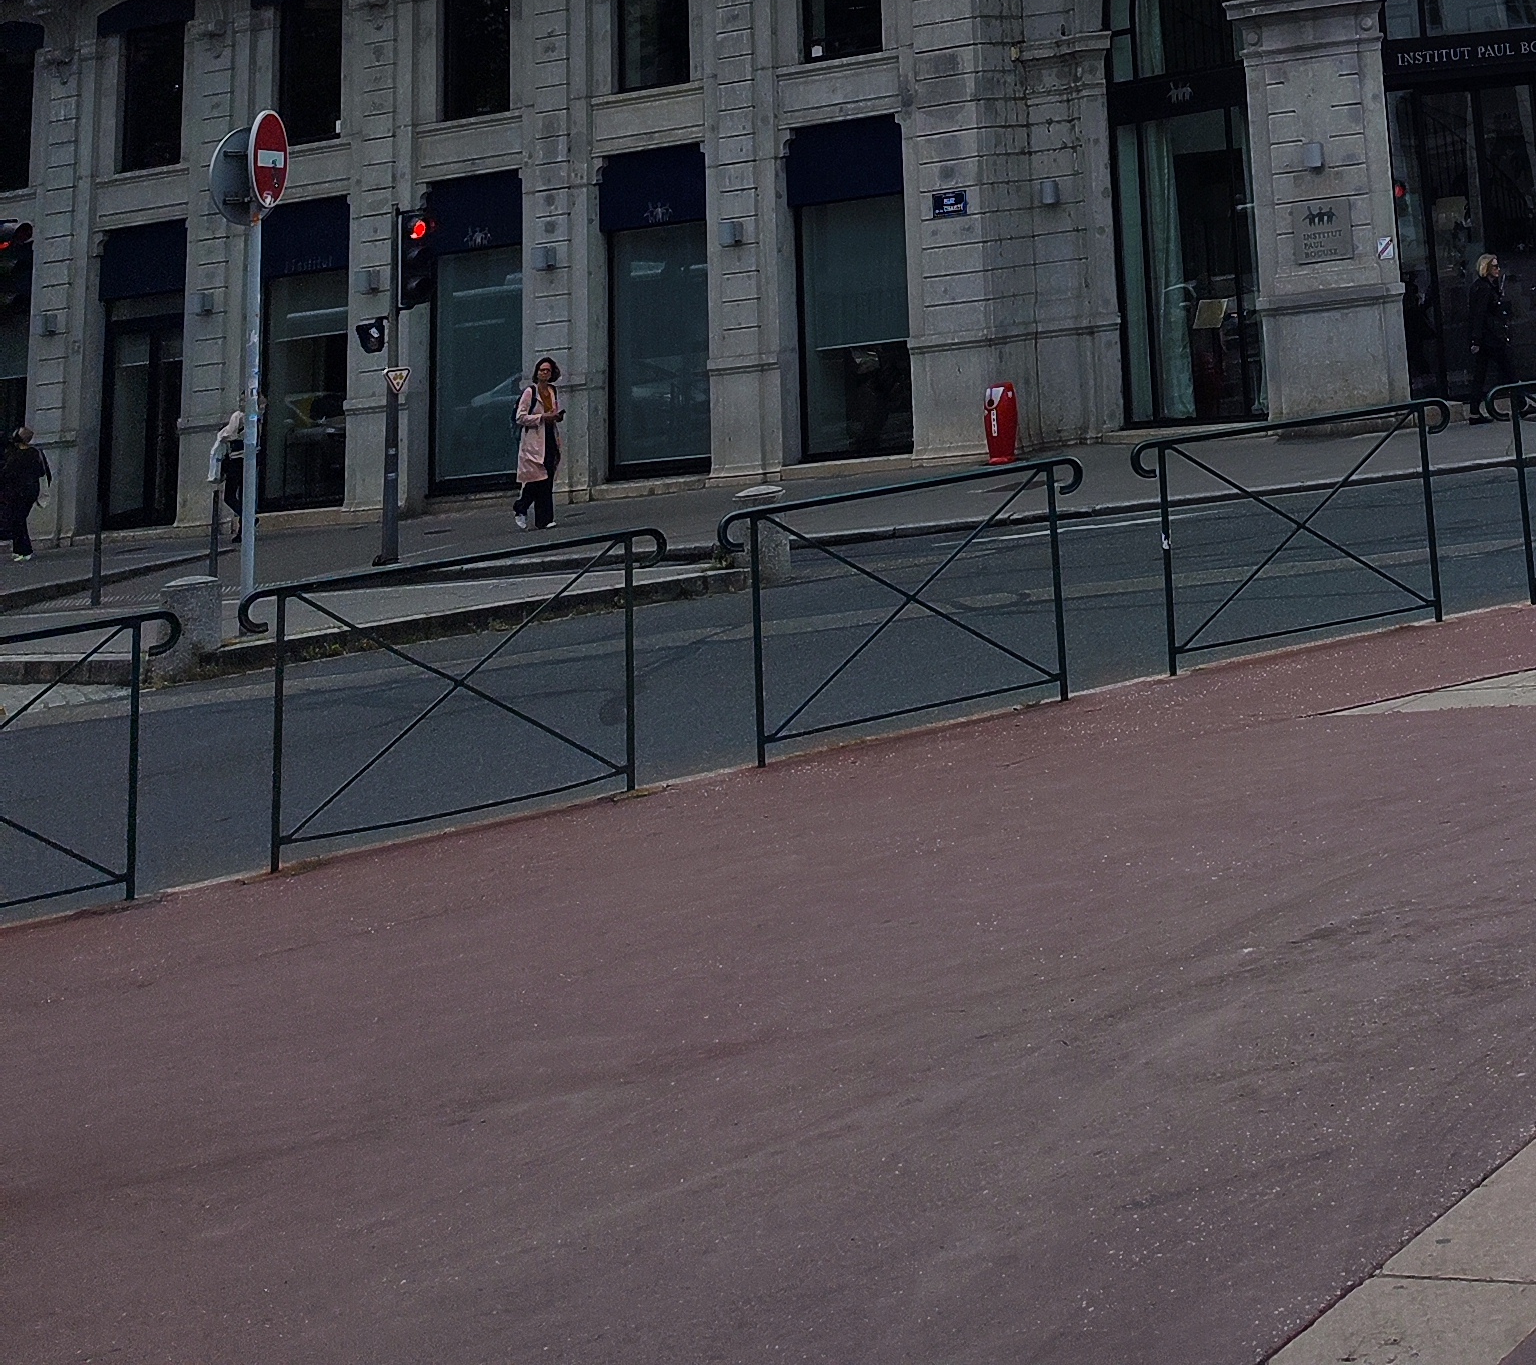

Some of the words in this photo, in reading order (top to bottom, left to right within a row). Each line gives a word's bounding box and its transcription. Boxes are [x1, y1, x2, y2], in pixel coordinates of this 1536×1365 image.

[1396, 46, 1472, 66] INSTITUT
[1477, 42, 1515, 58] PAUL
[1303, 229, 1343, 241] INSTITUT
[1303, 241, 1325, 250] PAUL
[1304, 248, 1339, 258] BOCUSE
